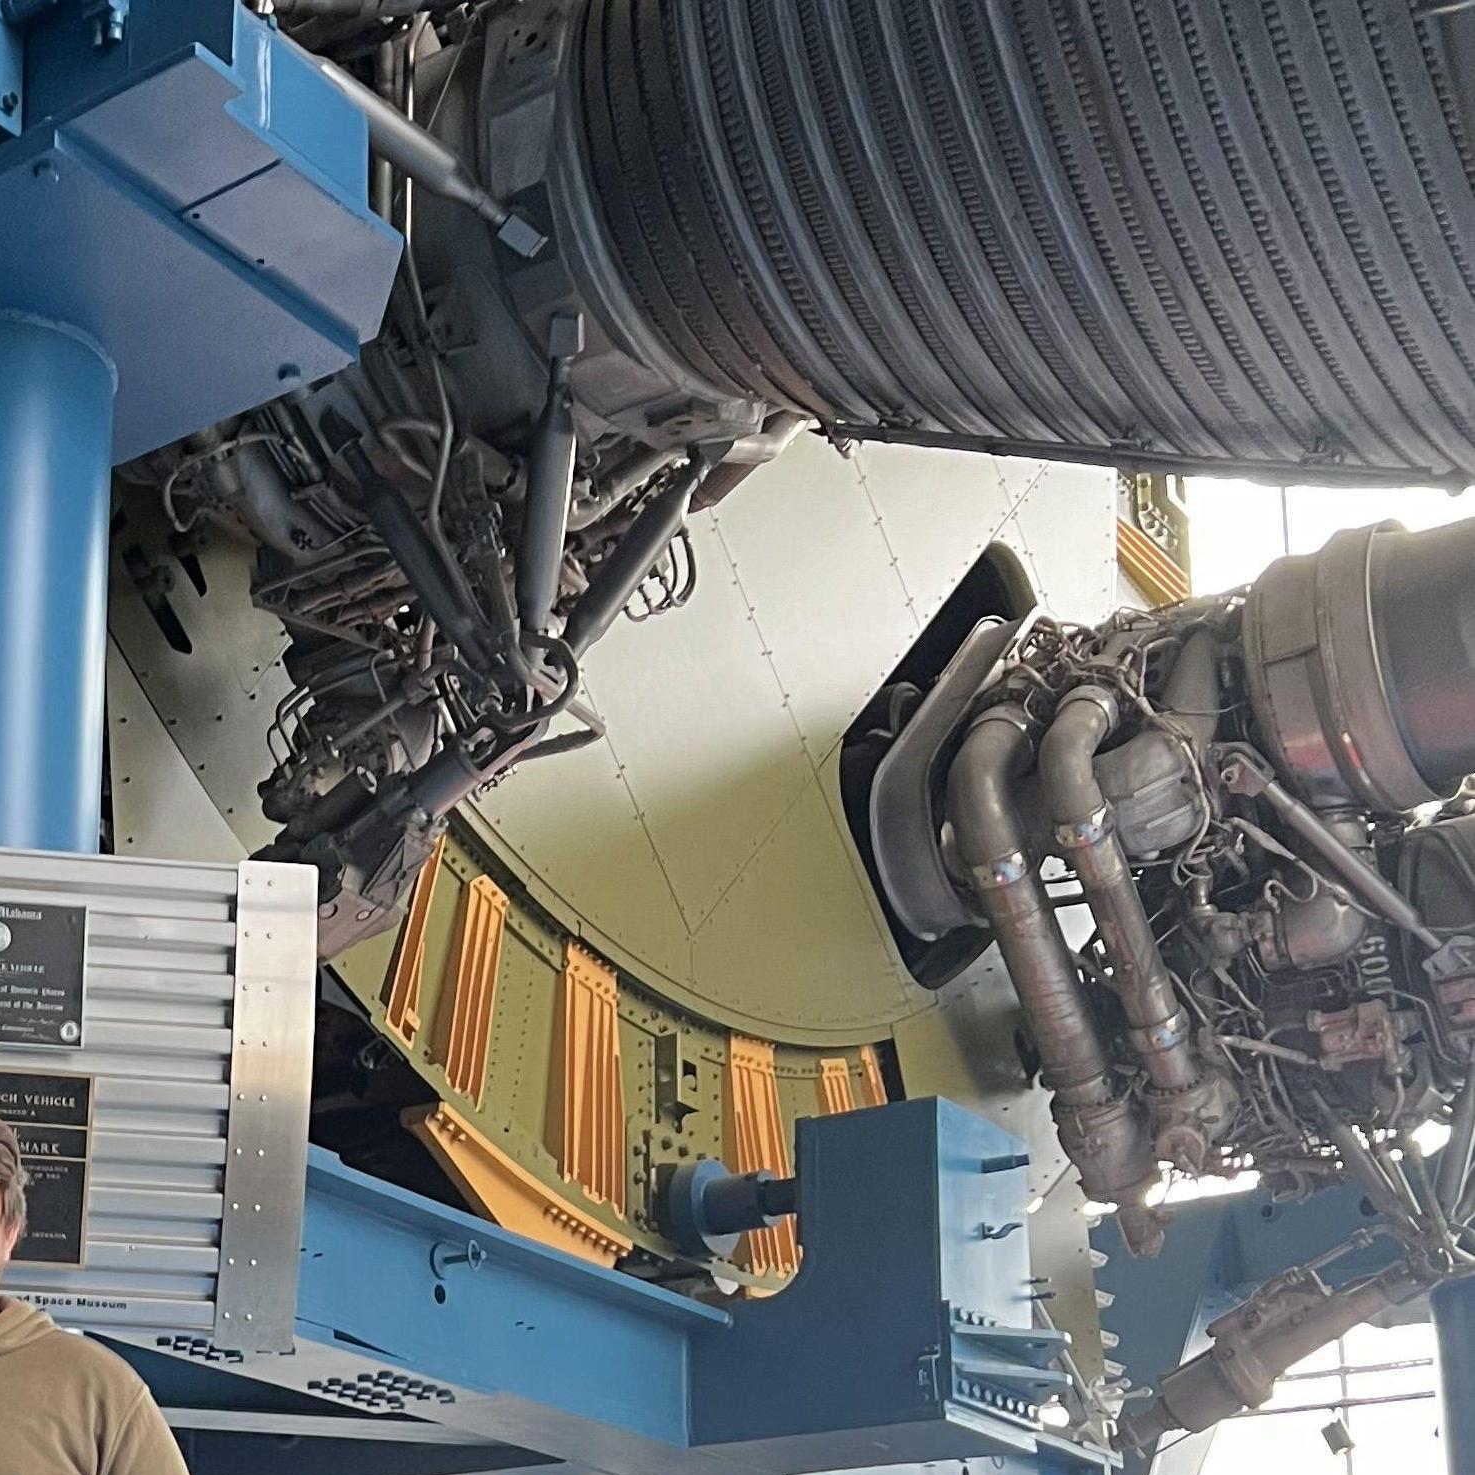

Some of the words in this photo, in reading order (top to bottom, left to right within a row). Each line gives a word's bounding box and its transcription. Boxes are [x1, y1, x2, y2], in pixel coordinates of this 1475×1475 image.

[25, 1094, 76, 1108] VEHICLE
[20, 1141, 60, 1155] MARK
[35, 1295, 72, 1307] Space
[77, 1298, 127, 1310] Museum
